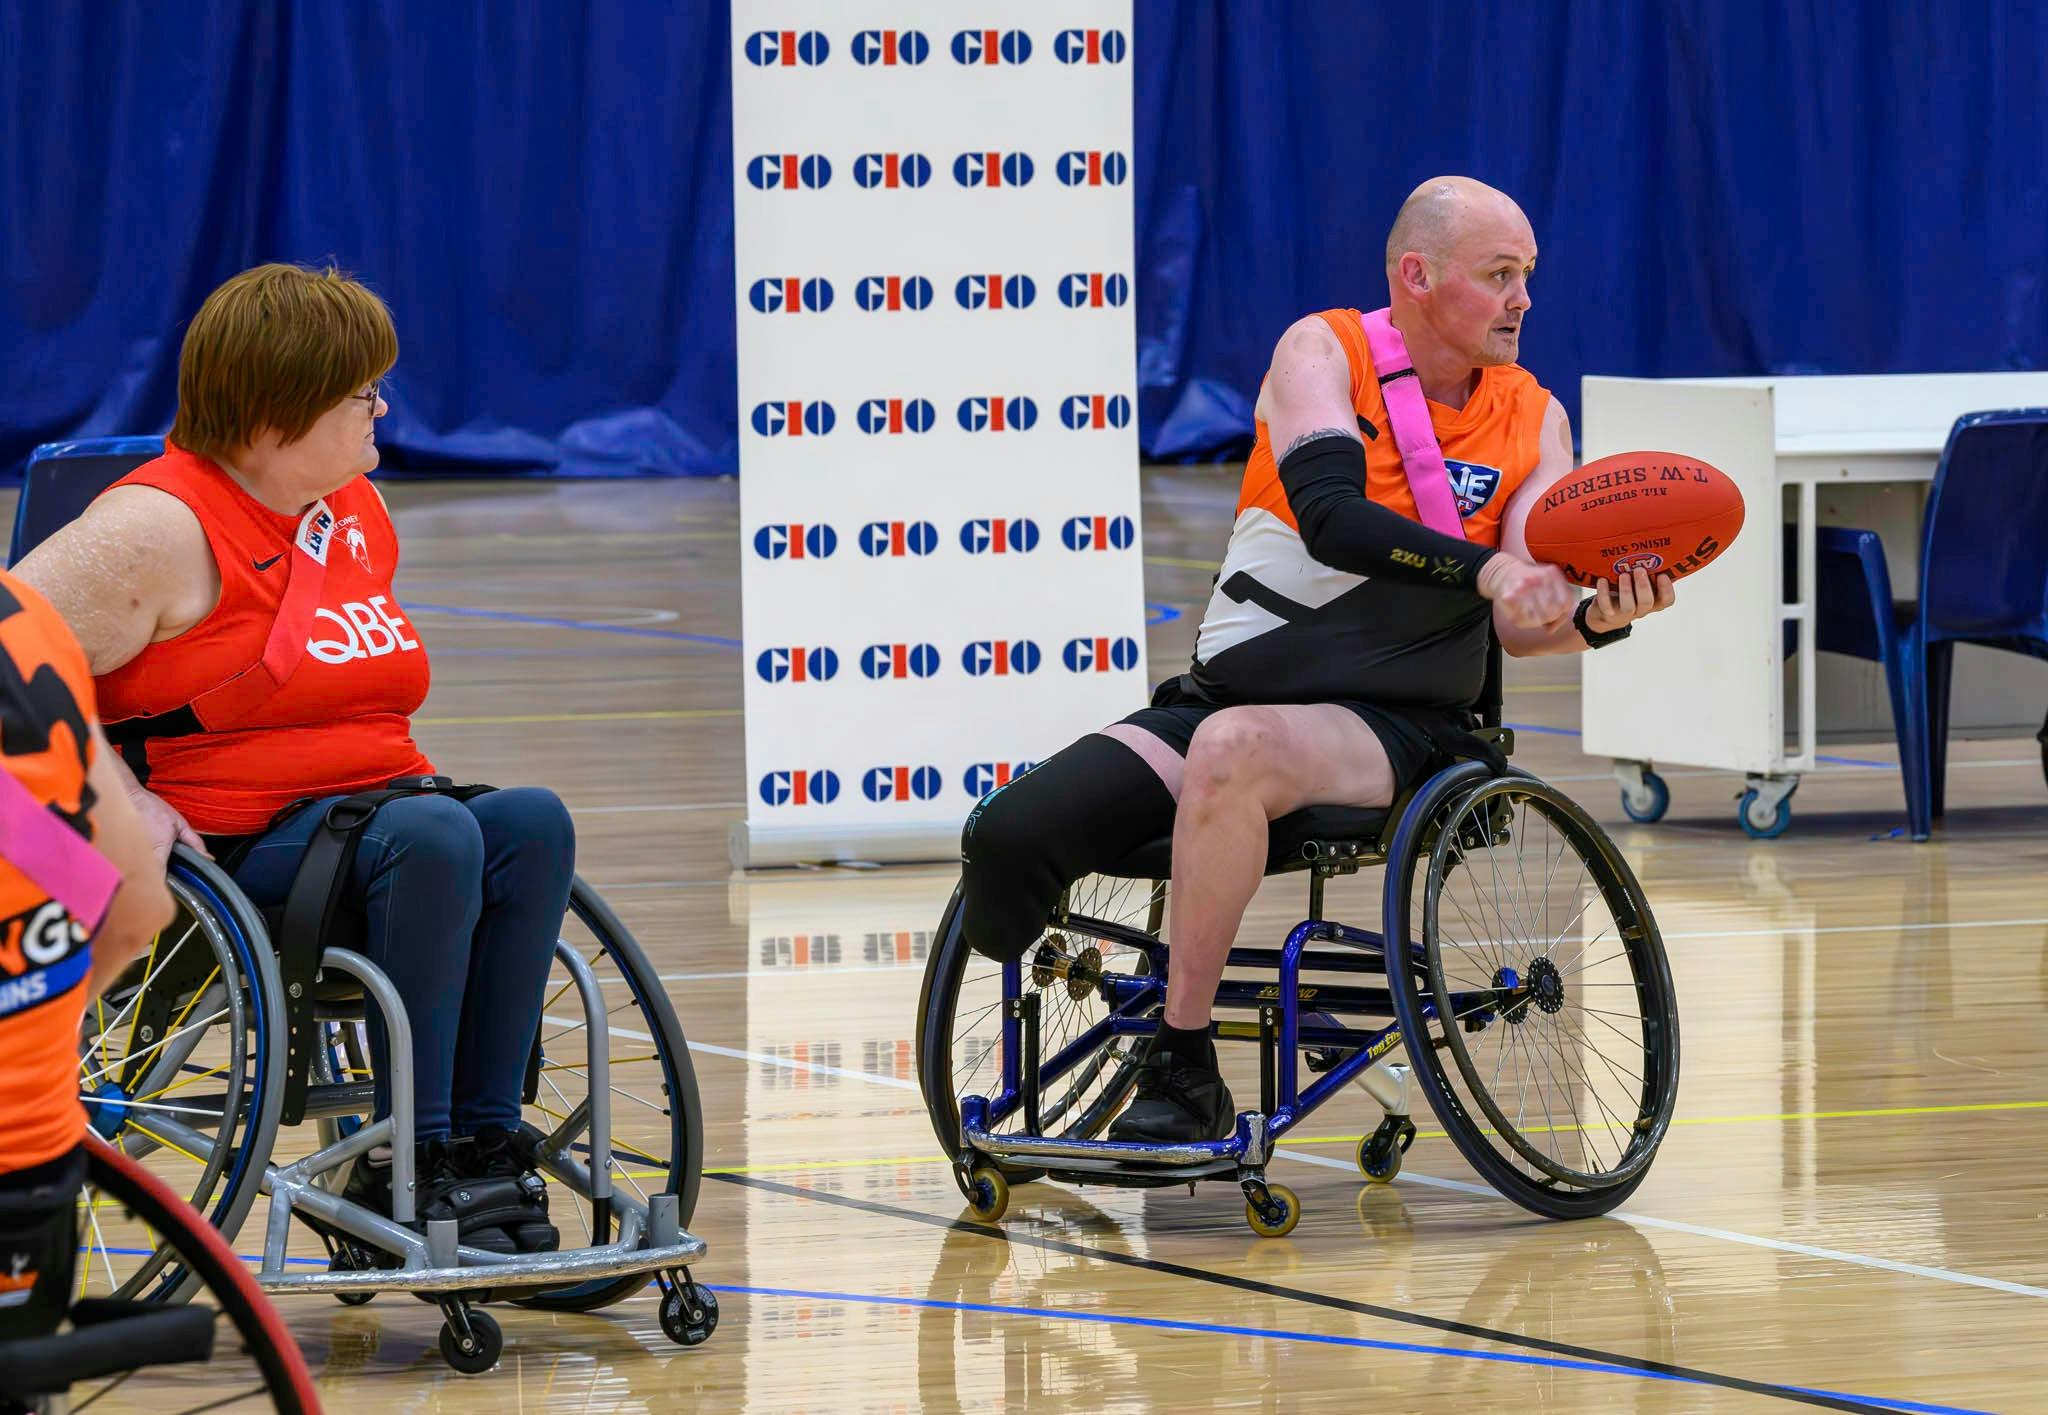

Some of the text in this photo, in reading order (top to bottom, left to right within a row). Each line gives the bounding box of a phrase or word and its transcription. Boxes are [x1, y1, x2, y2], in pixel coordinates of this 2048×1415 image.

[745, 29, 1126, 66] GIO GIO GIO GIO
[748, 151, 1126, 190] GIO GIO GIO GIO
[750, 273, 1128, 313] GIO GIO GIO GIO
[752, 395, 1130, 436] GIO GIO GIO GIO
[1456, 500, 1472, 510] FL
[1543, 467, 1647, 513] SHERRIN
[1580, 487, 1668, 512] ALL SURFACE
[310, 513, 332, 555] HART
[754, 516, 1134, 559] GIO GIO GIO GIO
[1600, 536, 1671, 559] RISING STAR
[306, 595, 419, 664] QBE
[756, 637, 1138, 683] GIO GIO GIO GIO
[759, 769, 840, 806] GIO
[863, 766, 941, 802] GIO
